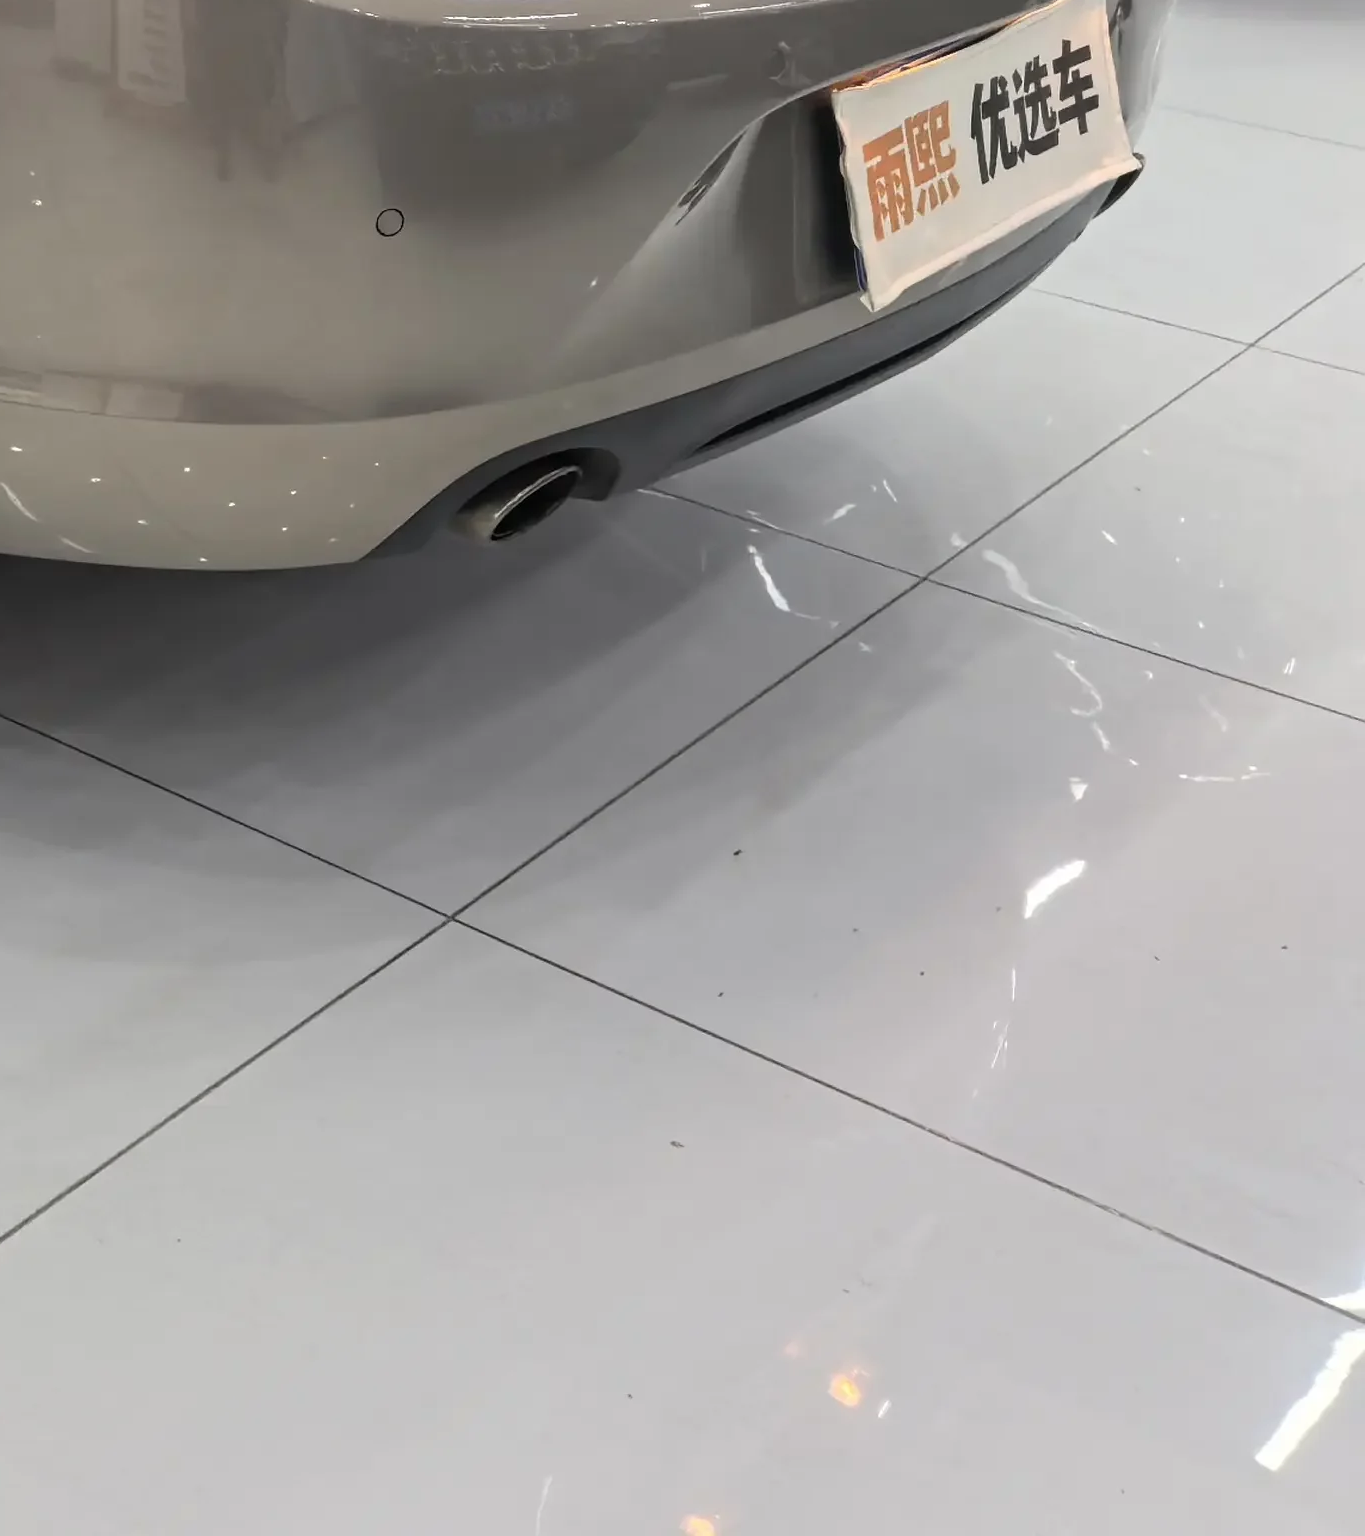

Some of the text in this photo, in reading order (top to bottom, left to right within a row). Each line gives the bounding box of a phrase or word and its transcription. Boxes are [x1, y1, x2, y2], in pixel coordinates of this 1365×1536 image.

[862, 39, 1099, 242] 雨熙 优选车
